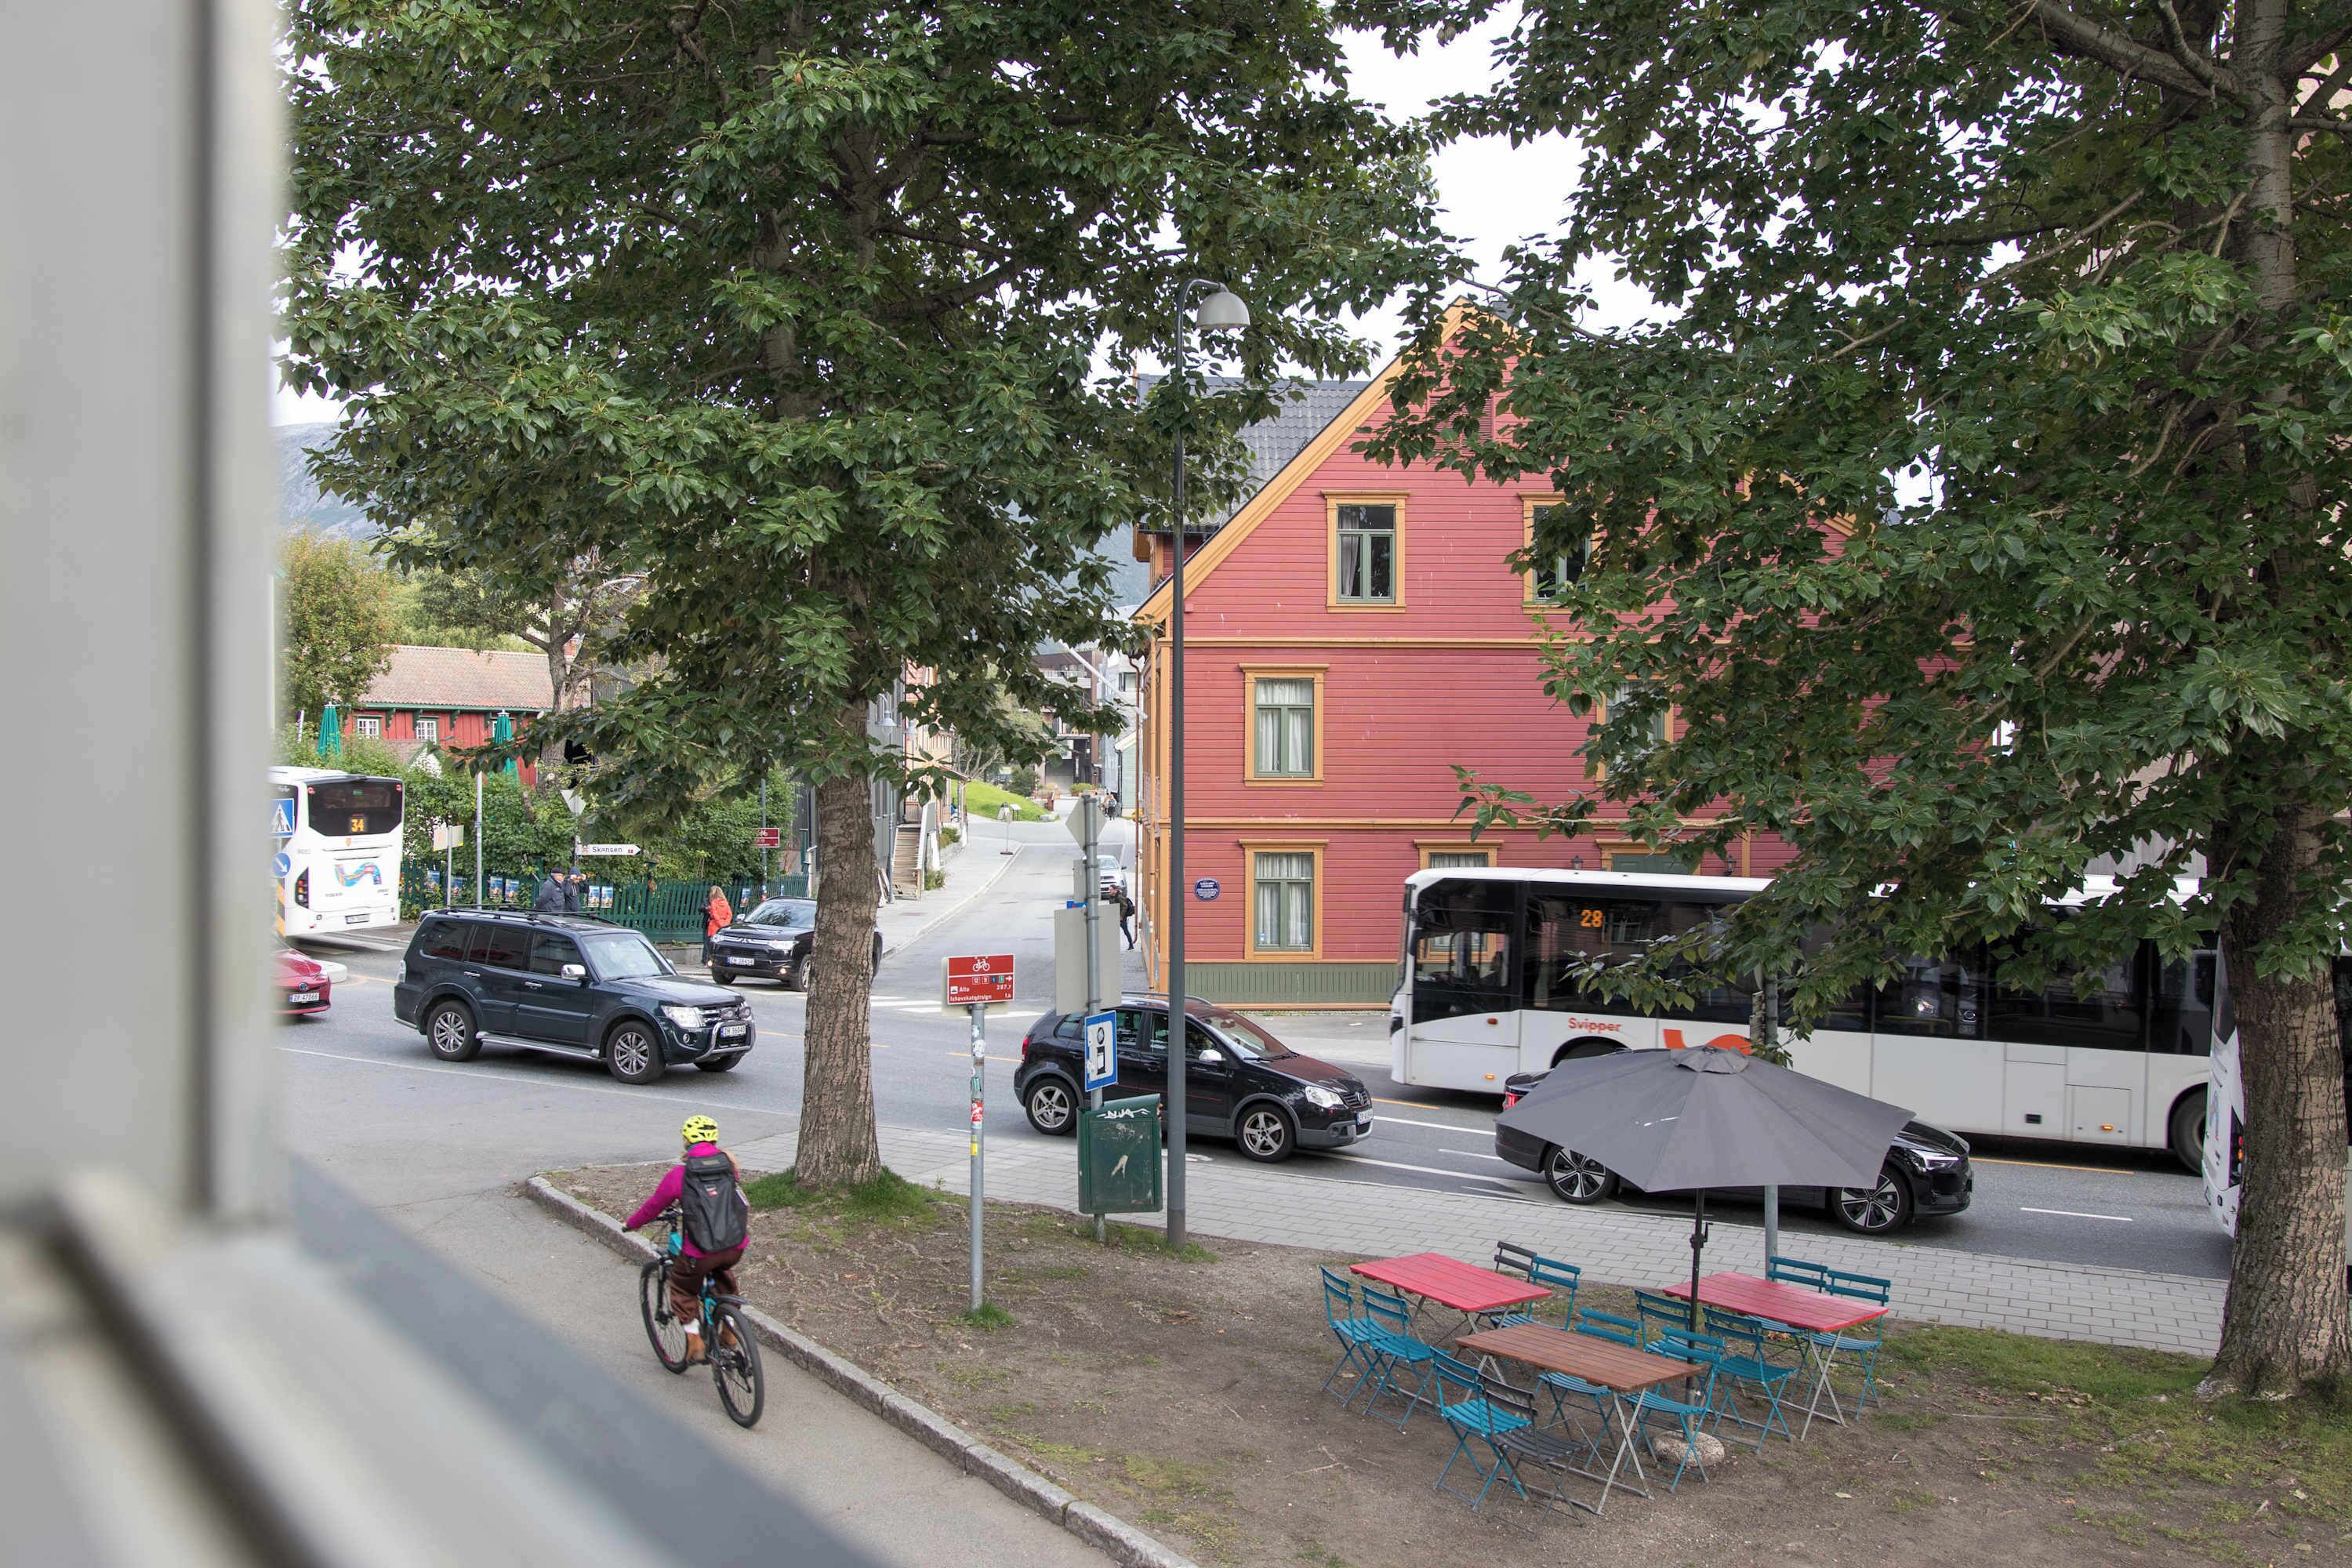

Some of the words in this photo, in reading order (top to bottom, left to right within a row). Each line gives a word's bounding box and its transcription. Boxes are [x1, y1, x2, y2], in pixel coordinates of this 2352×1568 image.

[350, 818, 364, 832] 34
[1581, 909, 1602, 927] 28
[1568, 1017, 1622, 1034] Svipper
